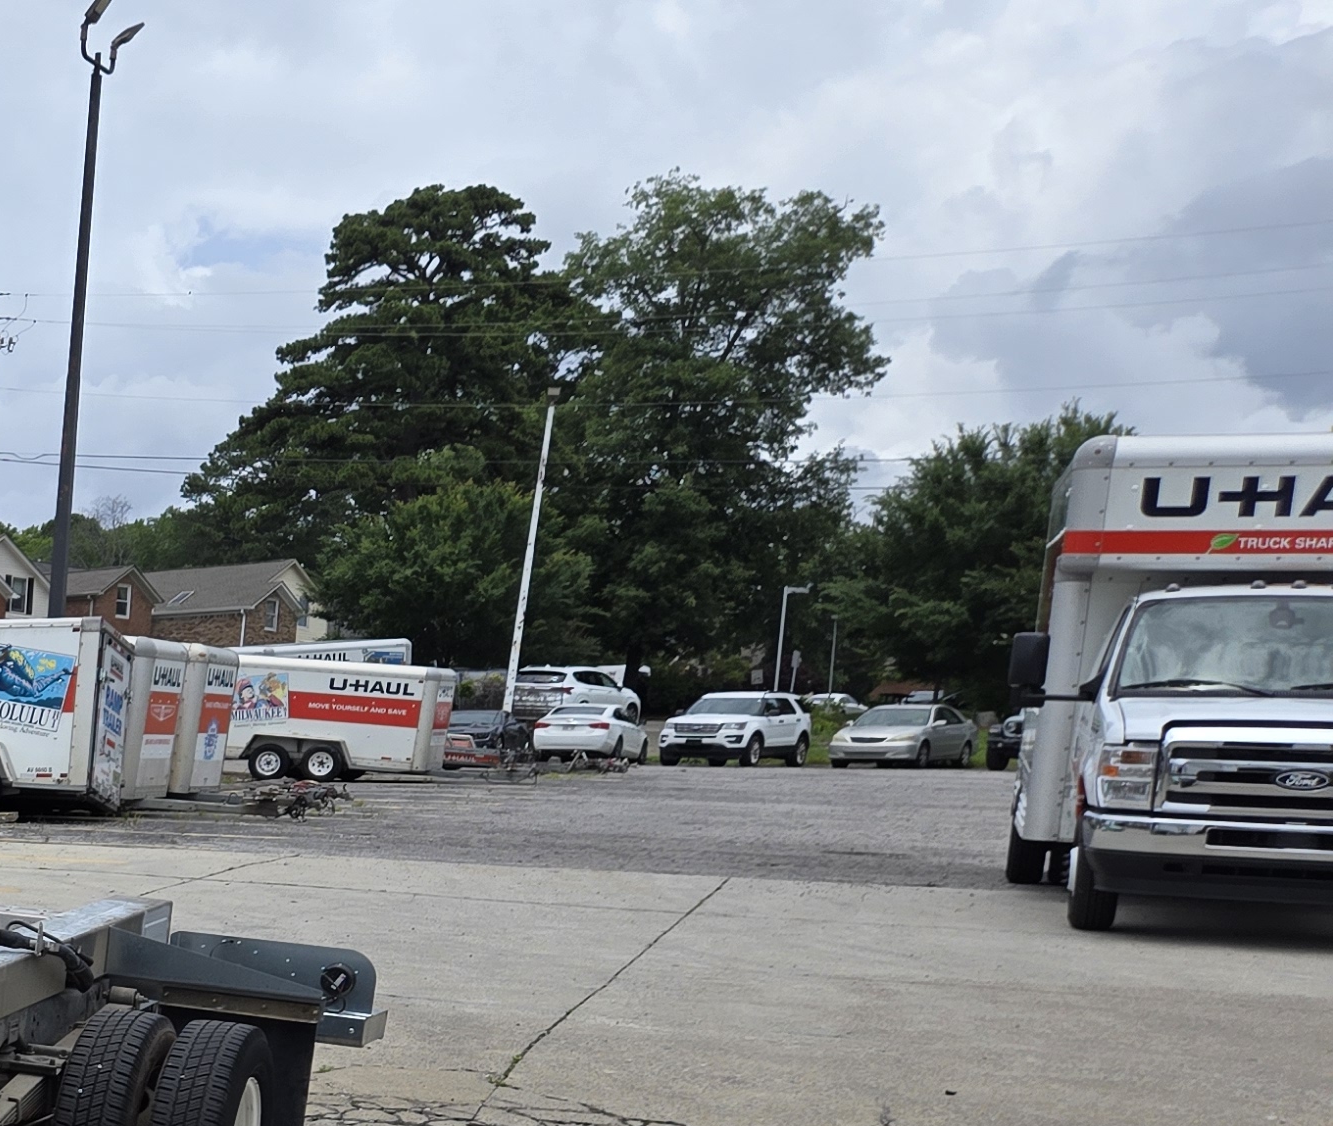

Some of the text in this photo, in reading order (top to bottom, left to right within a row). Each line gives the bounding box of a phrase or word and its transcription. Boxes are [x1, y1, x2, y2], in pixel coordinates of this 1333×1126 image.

[1140, 475, 1333, 517] U-HA
[1238, 537, 1290, 549] TRUCK
[231, 706, 282, 720] MILWAUKEE
[308, 702, 407, 716] MOVE YOURSELF AND SAVE
